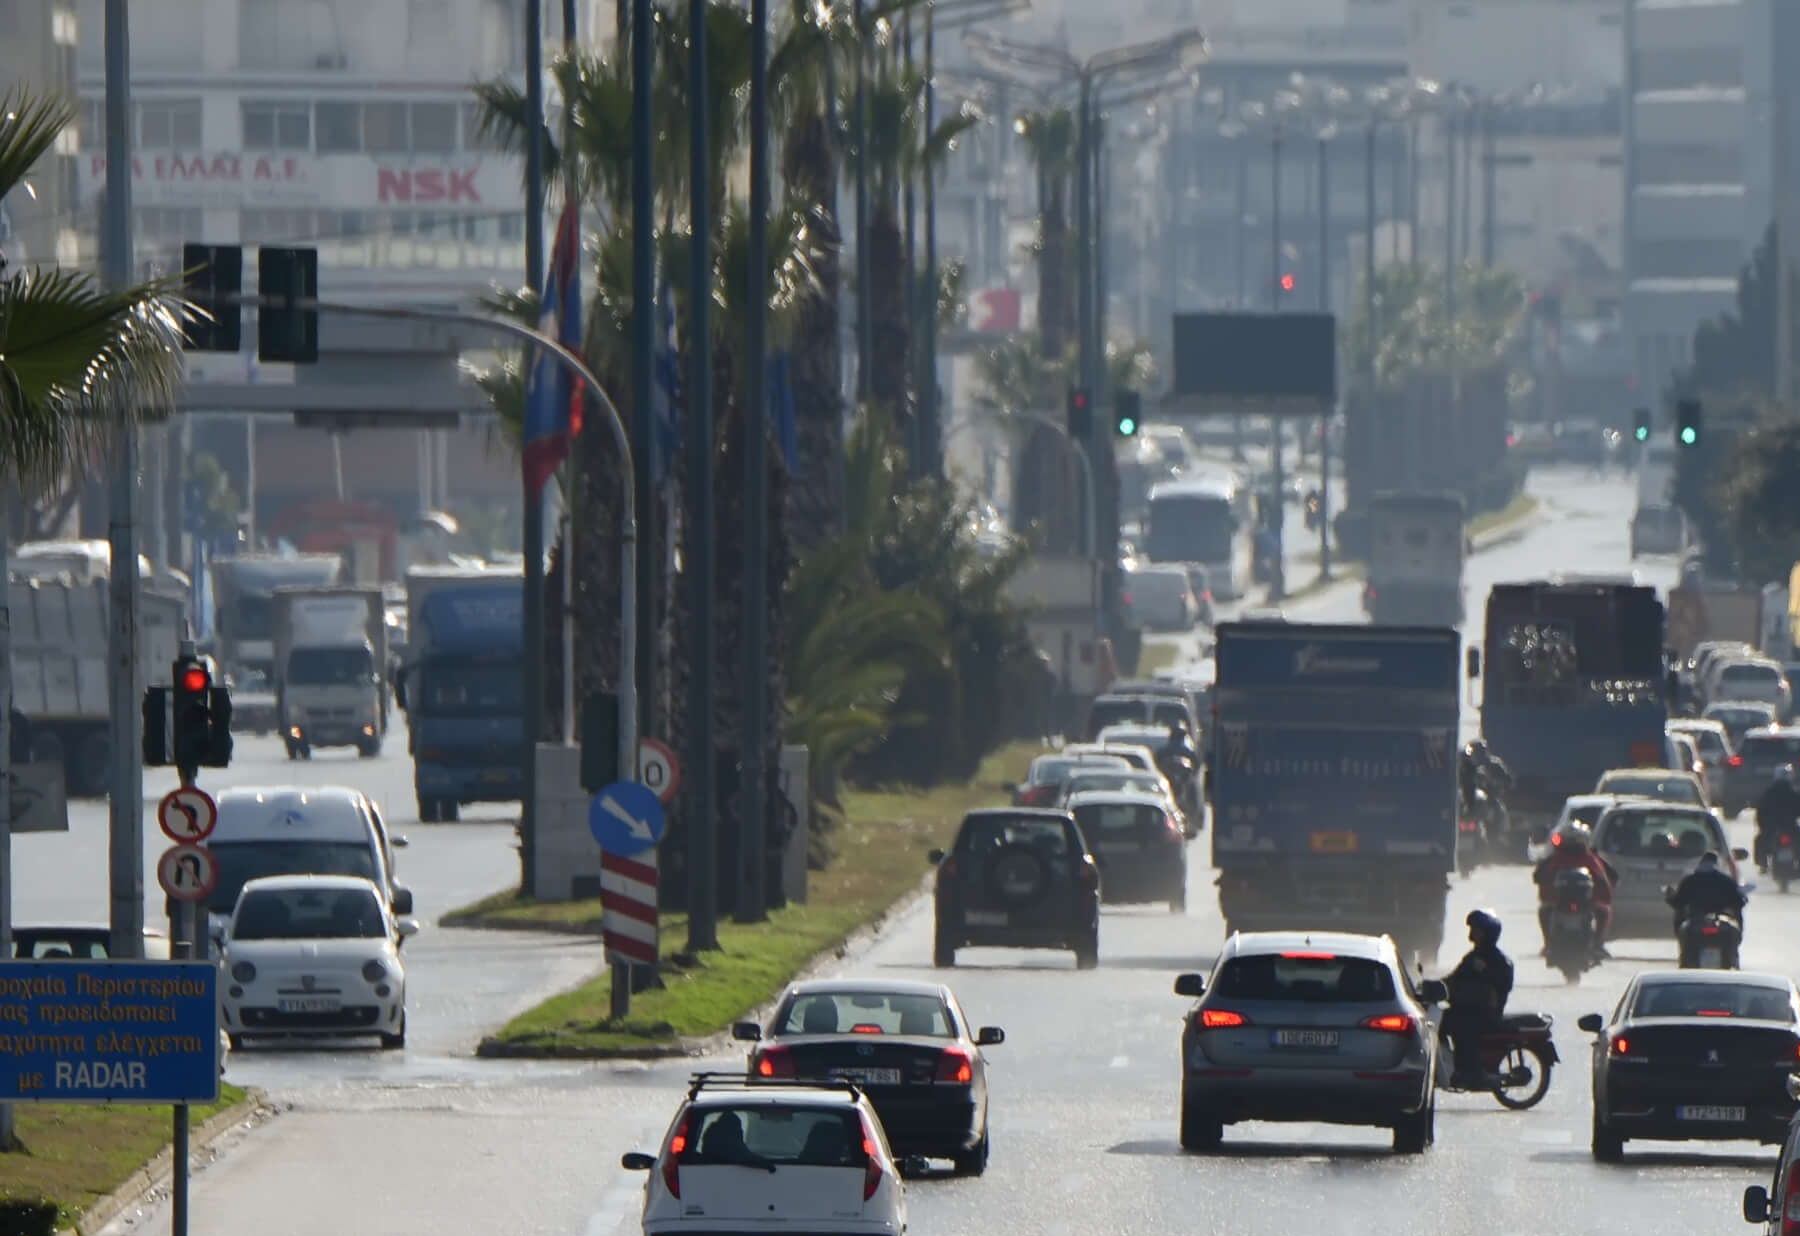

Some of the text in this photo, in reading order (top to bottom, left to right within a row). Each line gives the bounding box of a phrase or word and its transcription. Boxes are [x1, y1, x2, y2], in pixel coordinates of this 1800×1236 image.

[377, 166, 481, 204] NSK
[76, 972, 206, 1000] Περιστερίου
[96, 1031, 203, 1056] ελέγχεται
[18, 1061, 146, 1093] με RADAR
